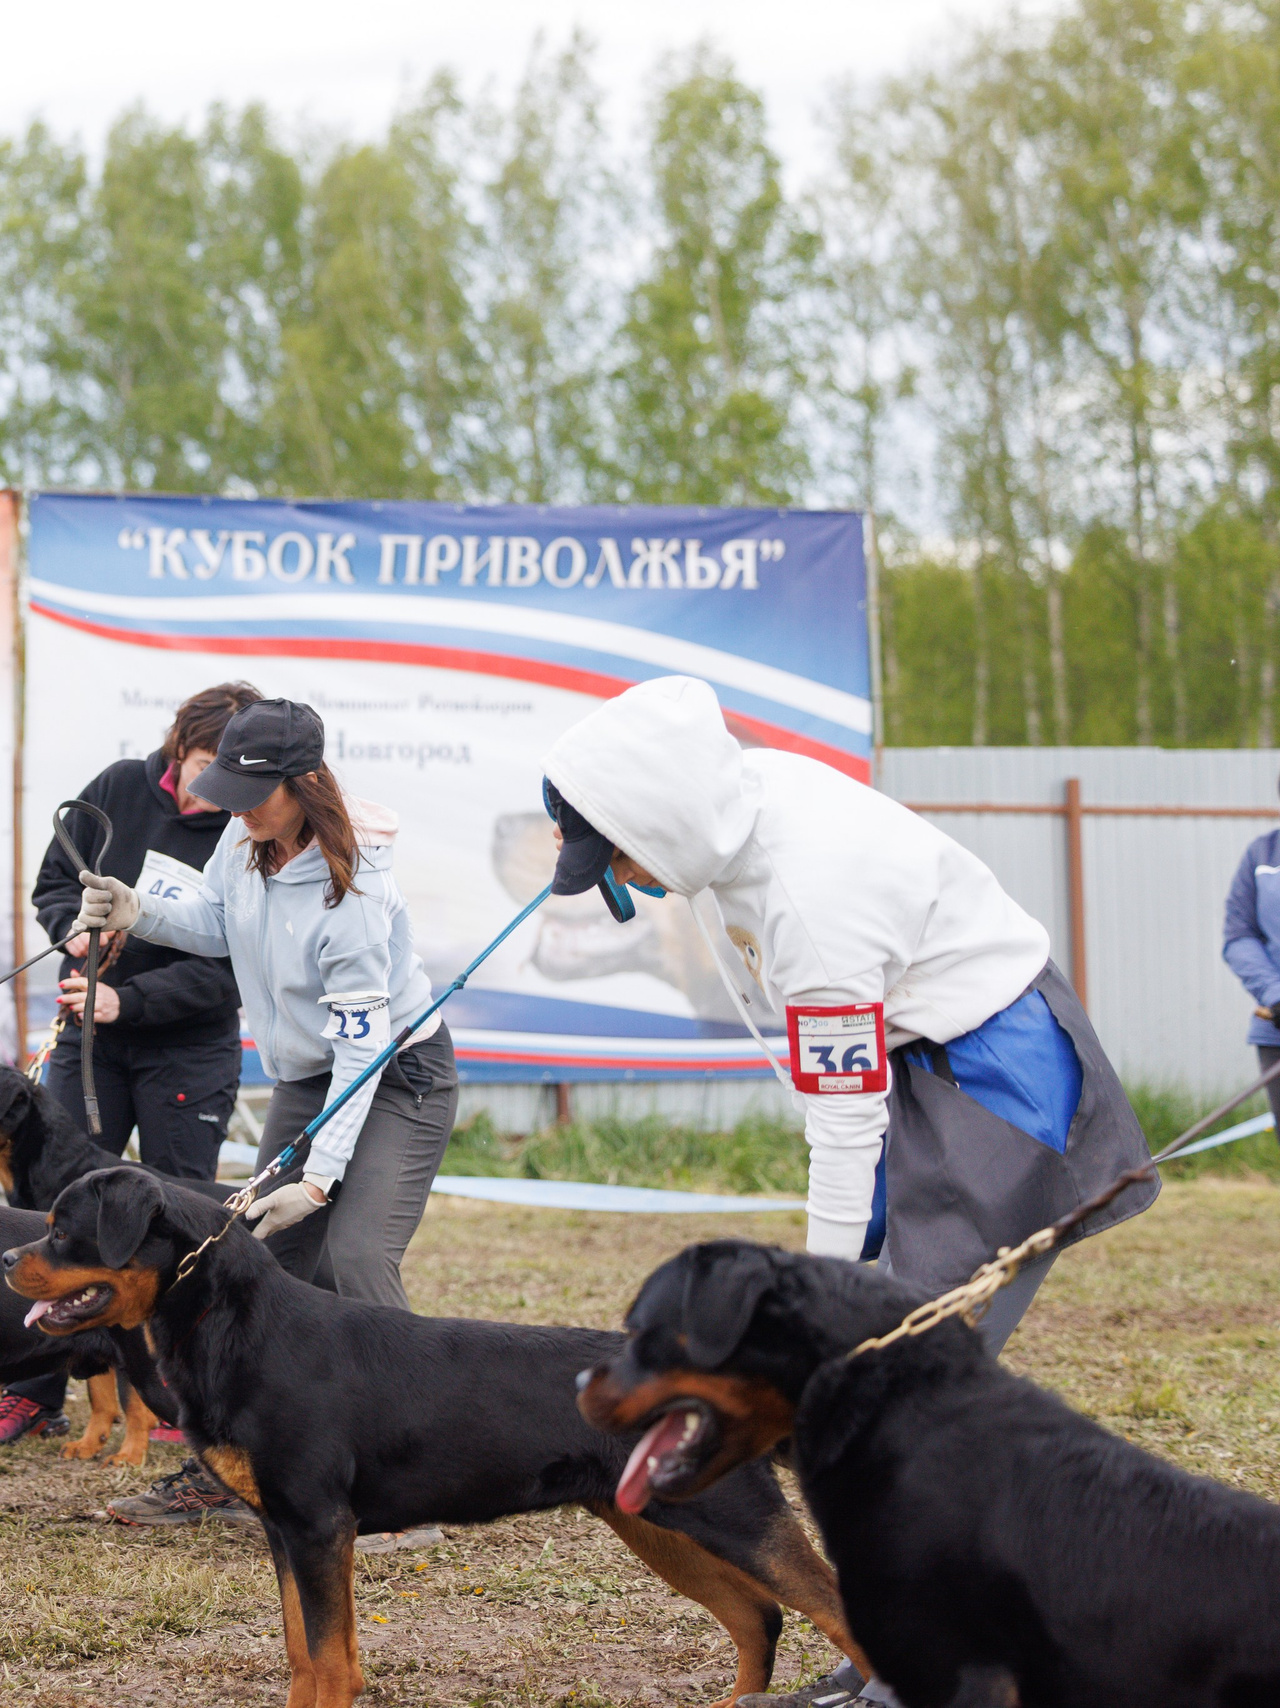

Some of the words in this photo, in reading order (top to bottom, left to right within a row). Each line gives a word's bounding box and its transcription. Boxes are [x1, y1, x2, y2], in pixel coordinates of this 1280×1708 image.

[118, 526, 356, 582] “КУБОК
[377, 533, 787, 591] ПРИВОЛЖЬЯ”
[808, 1044, 872, 1073] 36
